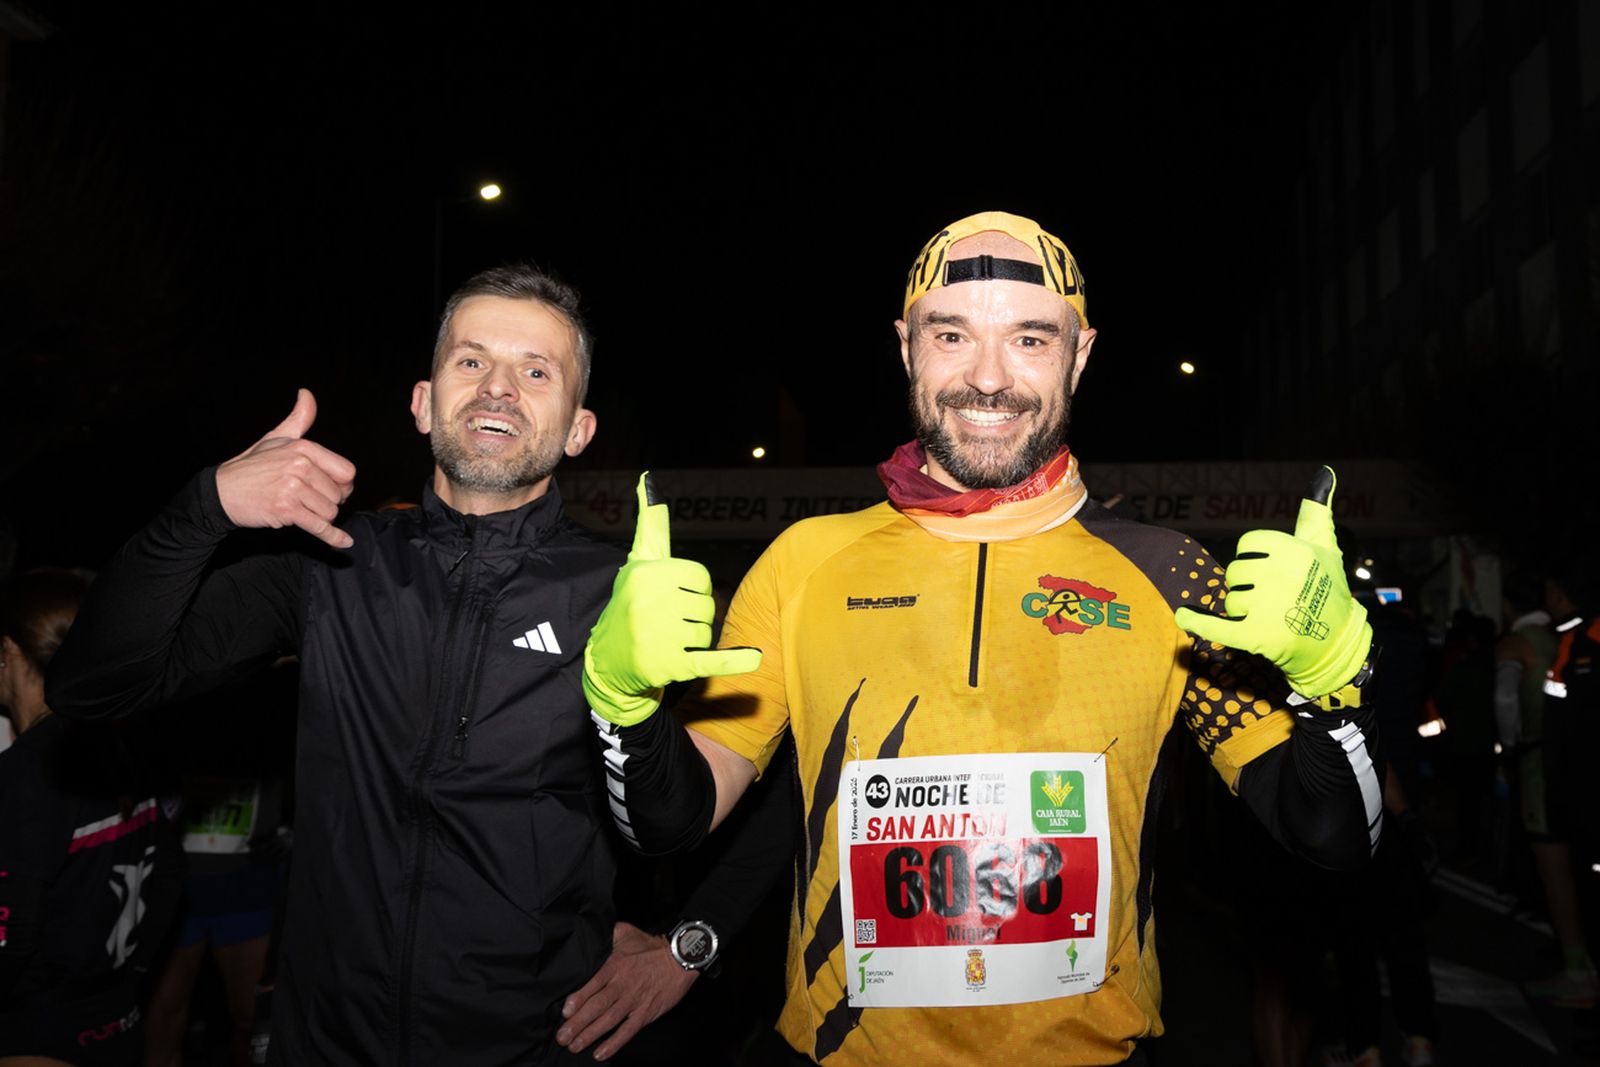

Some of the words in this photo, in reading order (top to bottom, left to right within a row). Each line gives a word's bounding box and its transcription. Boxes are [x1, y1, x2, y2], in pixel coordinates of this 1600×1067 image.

[589, 491, 621, 525] 43
[672, 496, 767, 521] RRERA
[1153, 495, 1193, 519] DE
[1204, 495, 1266, 519] SAN
[867, 782, 889, 799] 43
[895, 776, 924, 784] CARRERA
[925, 774, 952, 783] URBANA
[895, 784, 970, 808] NOCHE
[866, 815, 916, 842] SAN
